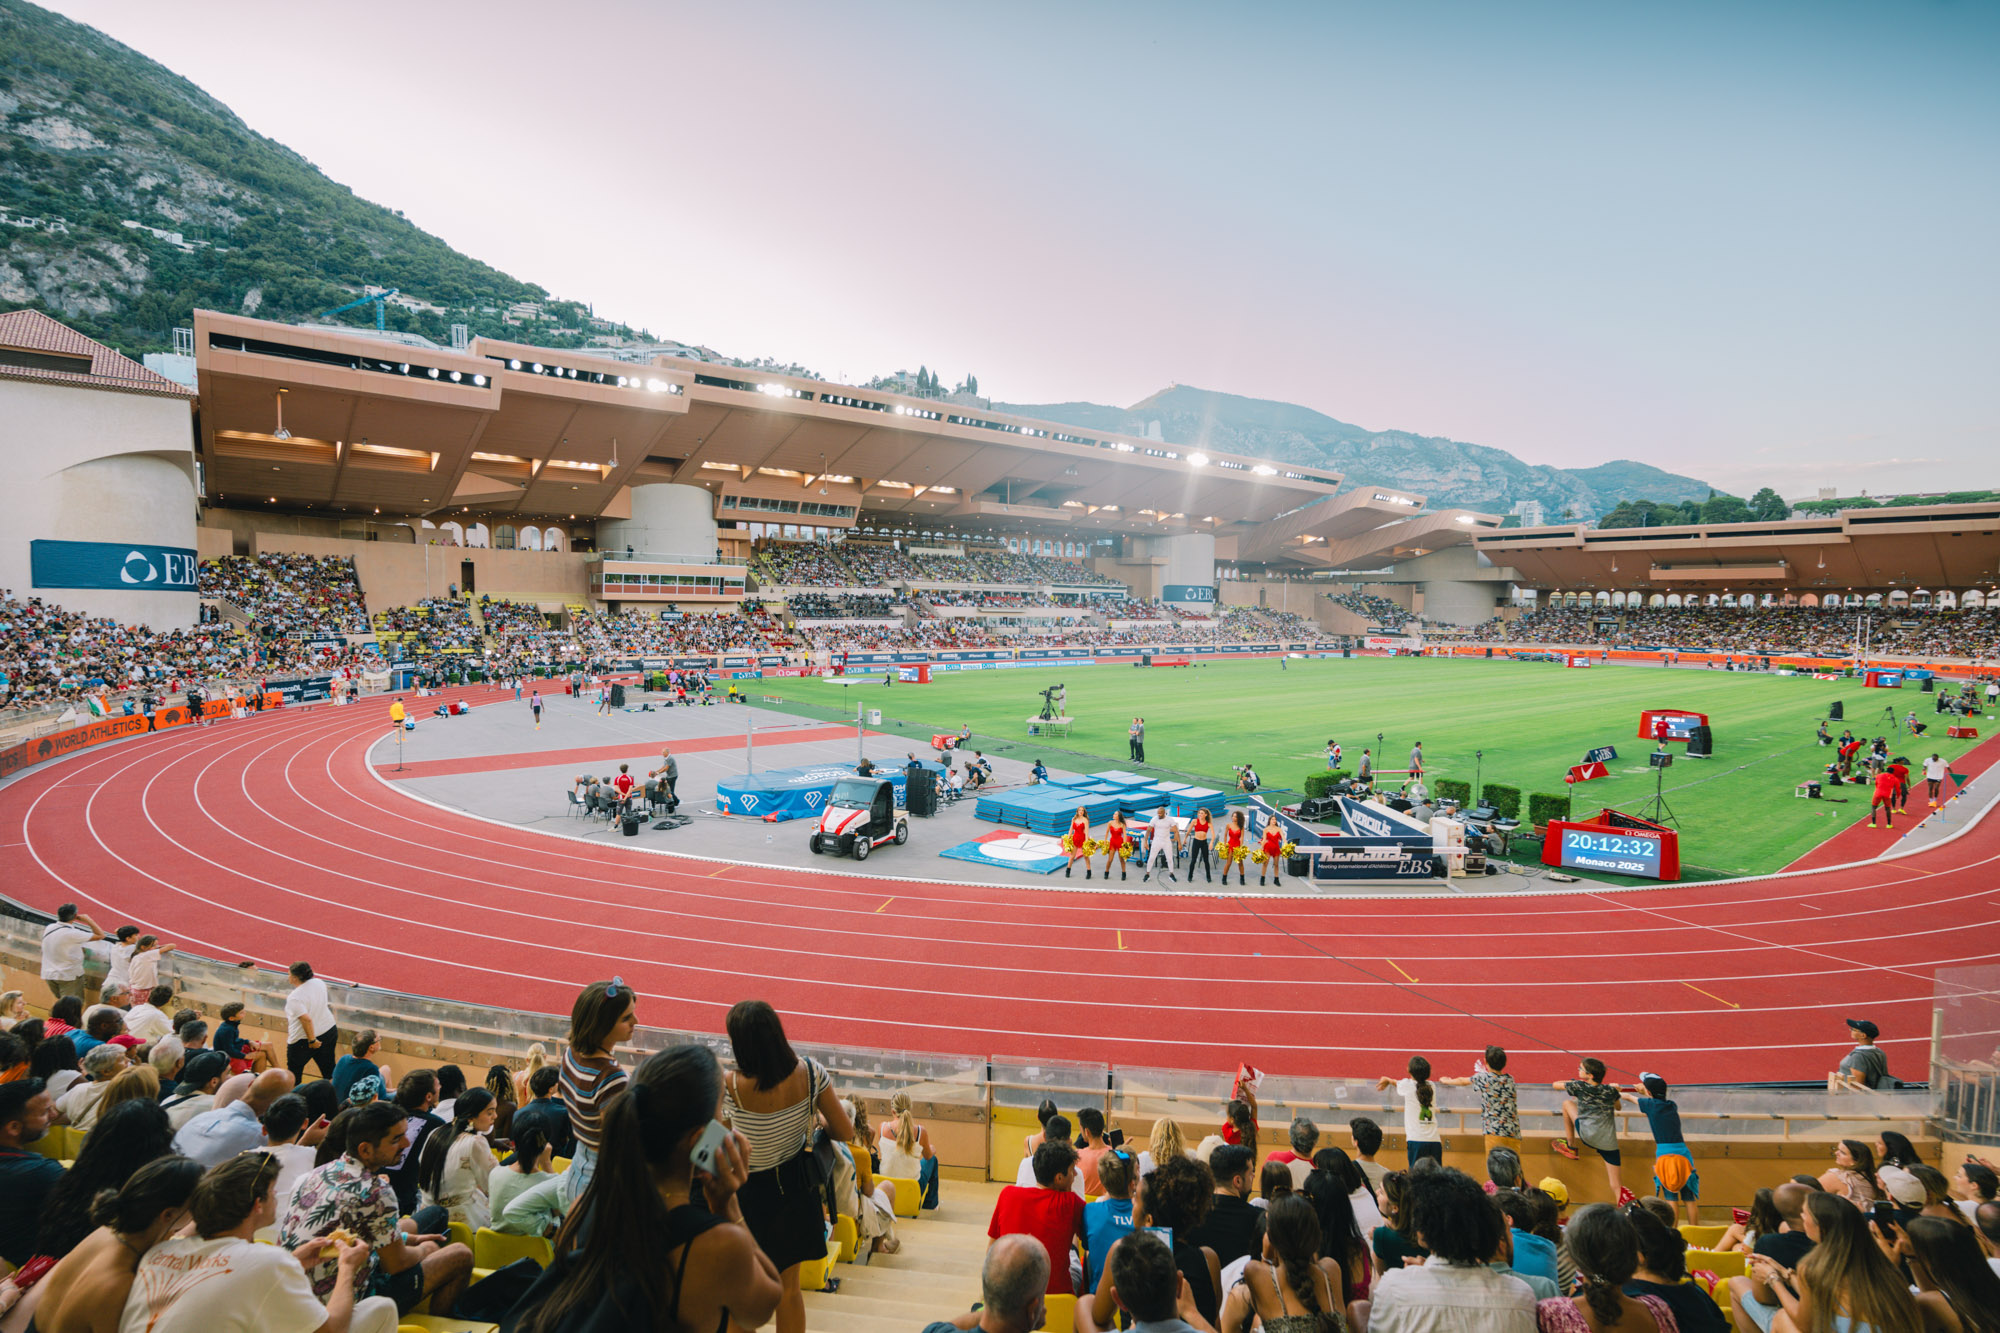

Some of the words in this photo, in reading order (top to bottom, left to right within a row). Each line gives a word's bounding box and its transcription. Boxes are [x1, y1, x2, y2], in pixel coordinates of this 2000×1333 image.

[1198, 587, 1214, 600] EBS
[54, 731, 88, 751] WORLD
[89, 718, 142, 741] ATHLETICS
[1600, 748, 1613, 760] EBS
[1634, 830, 1661, 839] OMEGA
[1568, 833, 1654, 857] 20:12:32
[1396, 859, 1433, 874] EBS
[1575, 856, 1616, 868] Monaco
[1617, 861, 1645, 872] 2025
[148, 1250, 187, 1271] Central
[188, 1253, 231, 1271] Works
